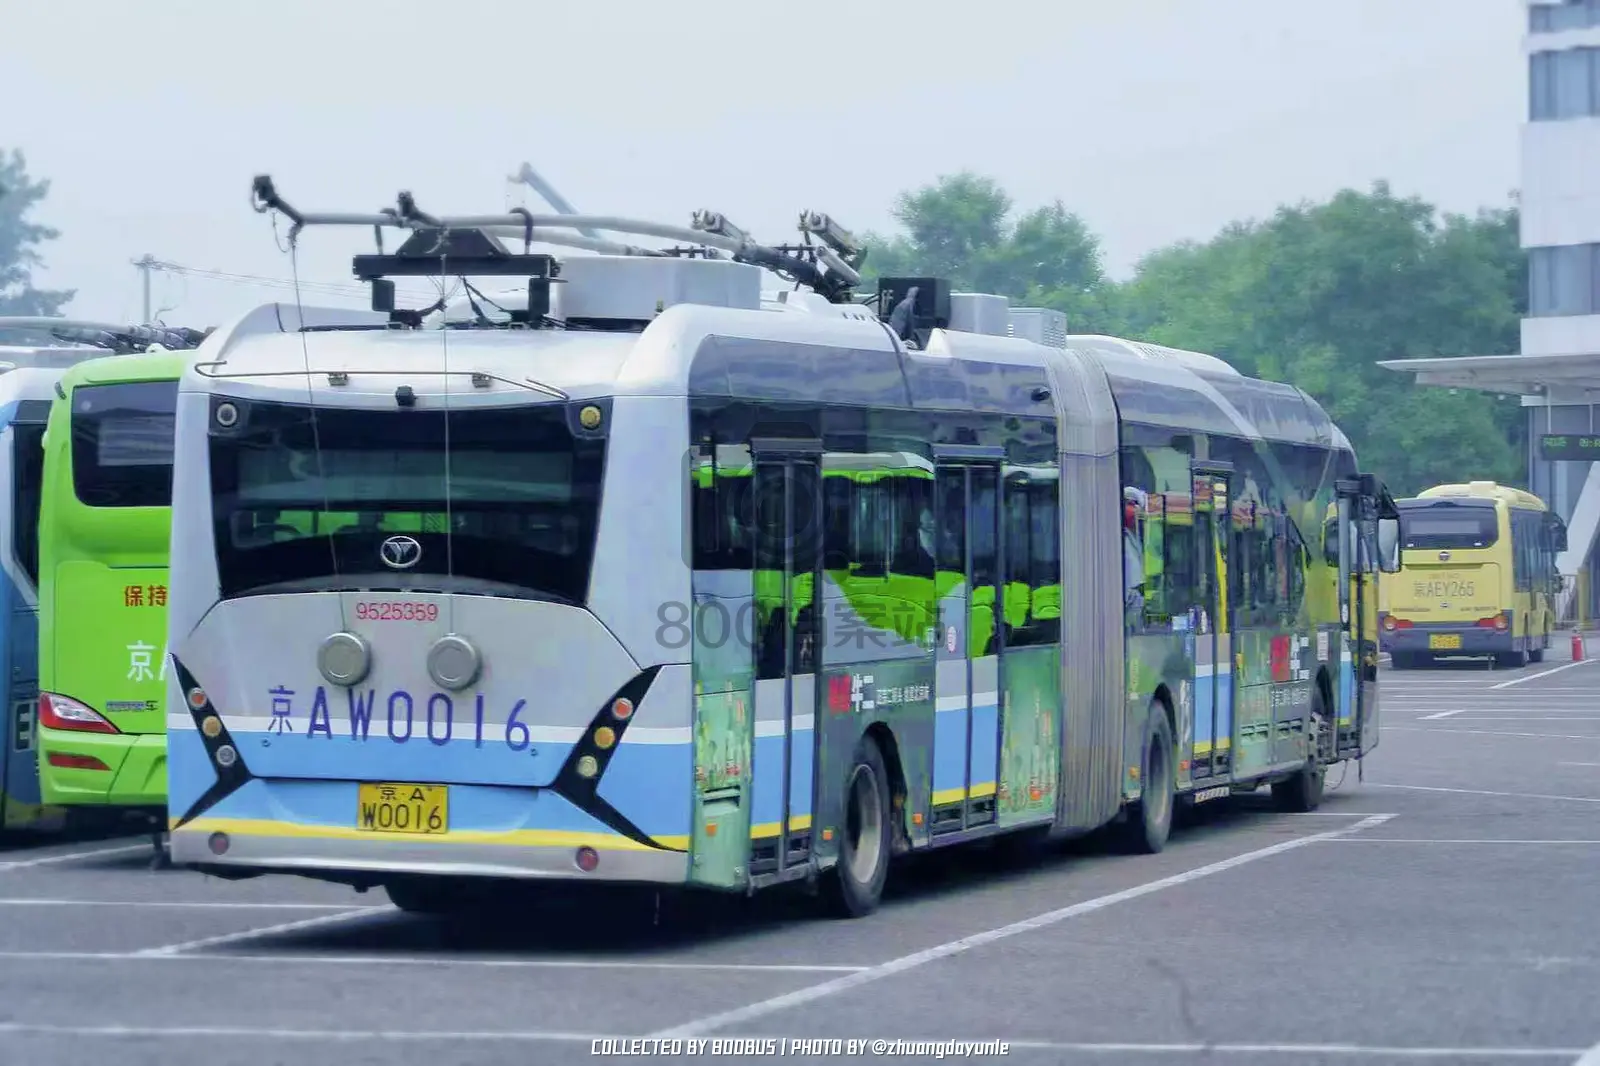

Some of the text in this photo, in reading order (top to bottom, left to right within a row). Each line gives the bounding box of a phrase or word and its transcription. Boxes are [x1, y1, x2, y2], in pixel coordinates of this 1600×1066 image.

[124, 585, 167, 607] 保持
[356, 602, 439, 621] 9525359
[267, 684, 531, 752] 京AW0016
[361, 802, 443, 830] W0016
